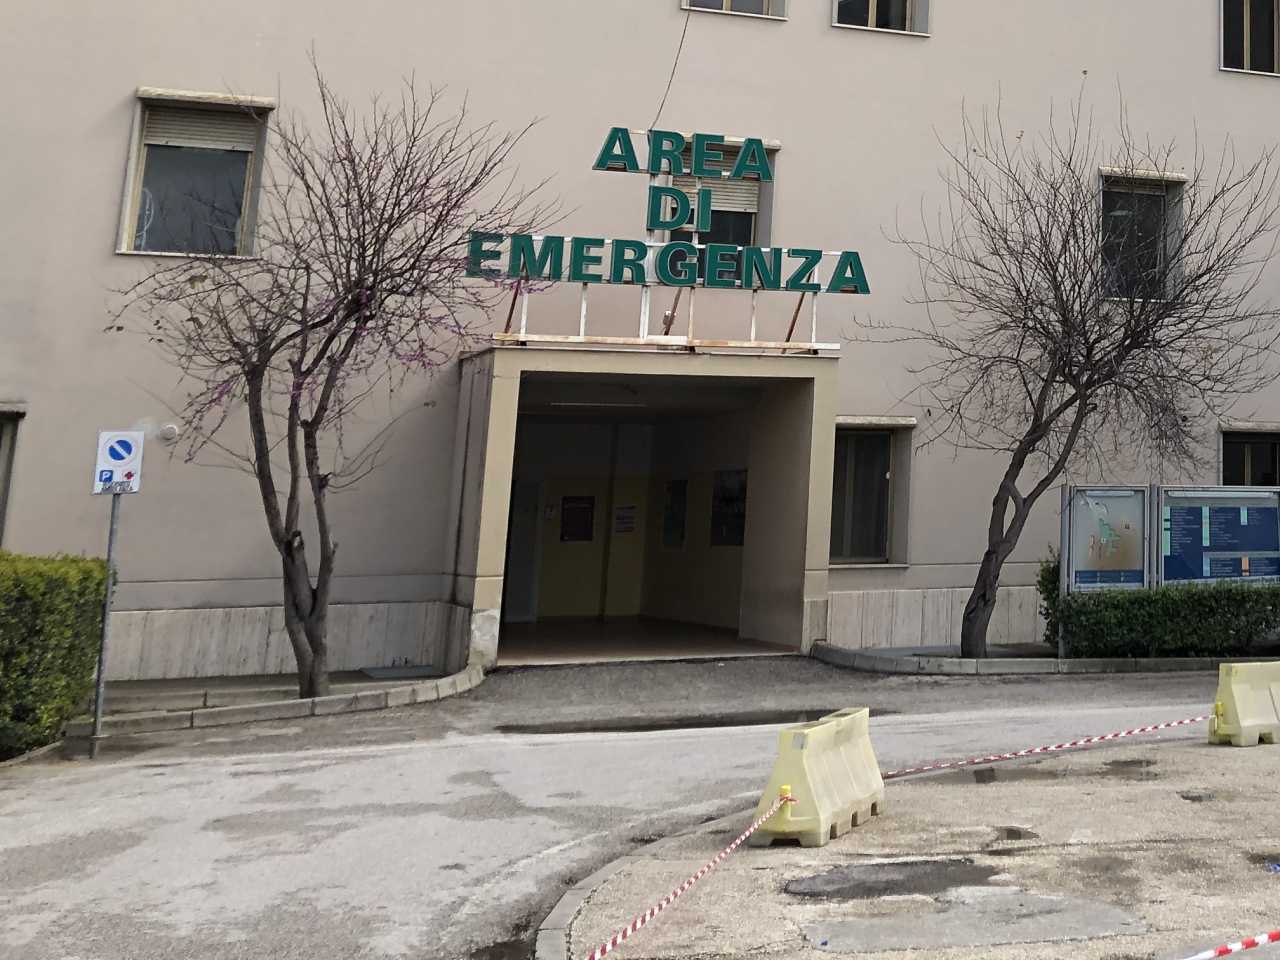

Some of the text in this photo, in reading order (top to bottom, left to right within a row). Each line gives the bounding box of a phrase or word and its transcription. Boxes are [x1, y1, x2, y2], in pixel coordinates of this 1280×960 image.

[593, 127, 772, 182] AREA
[647, 186, 711, 233] DI
[466, 230, 871, 295] EMERGENZA
